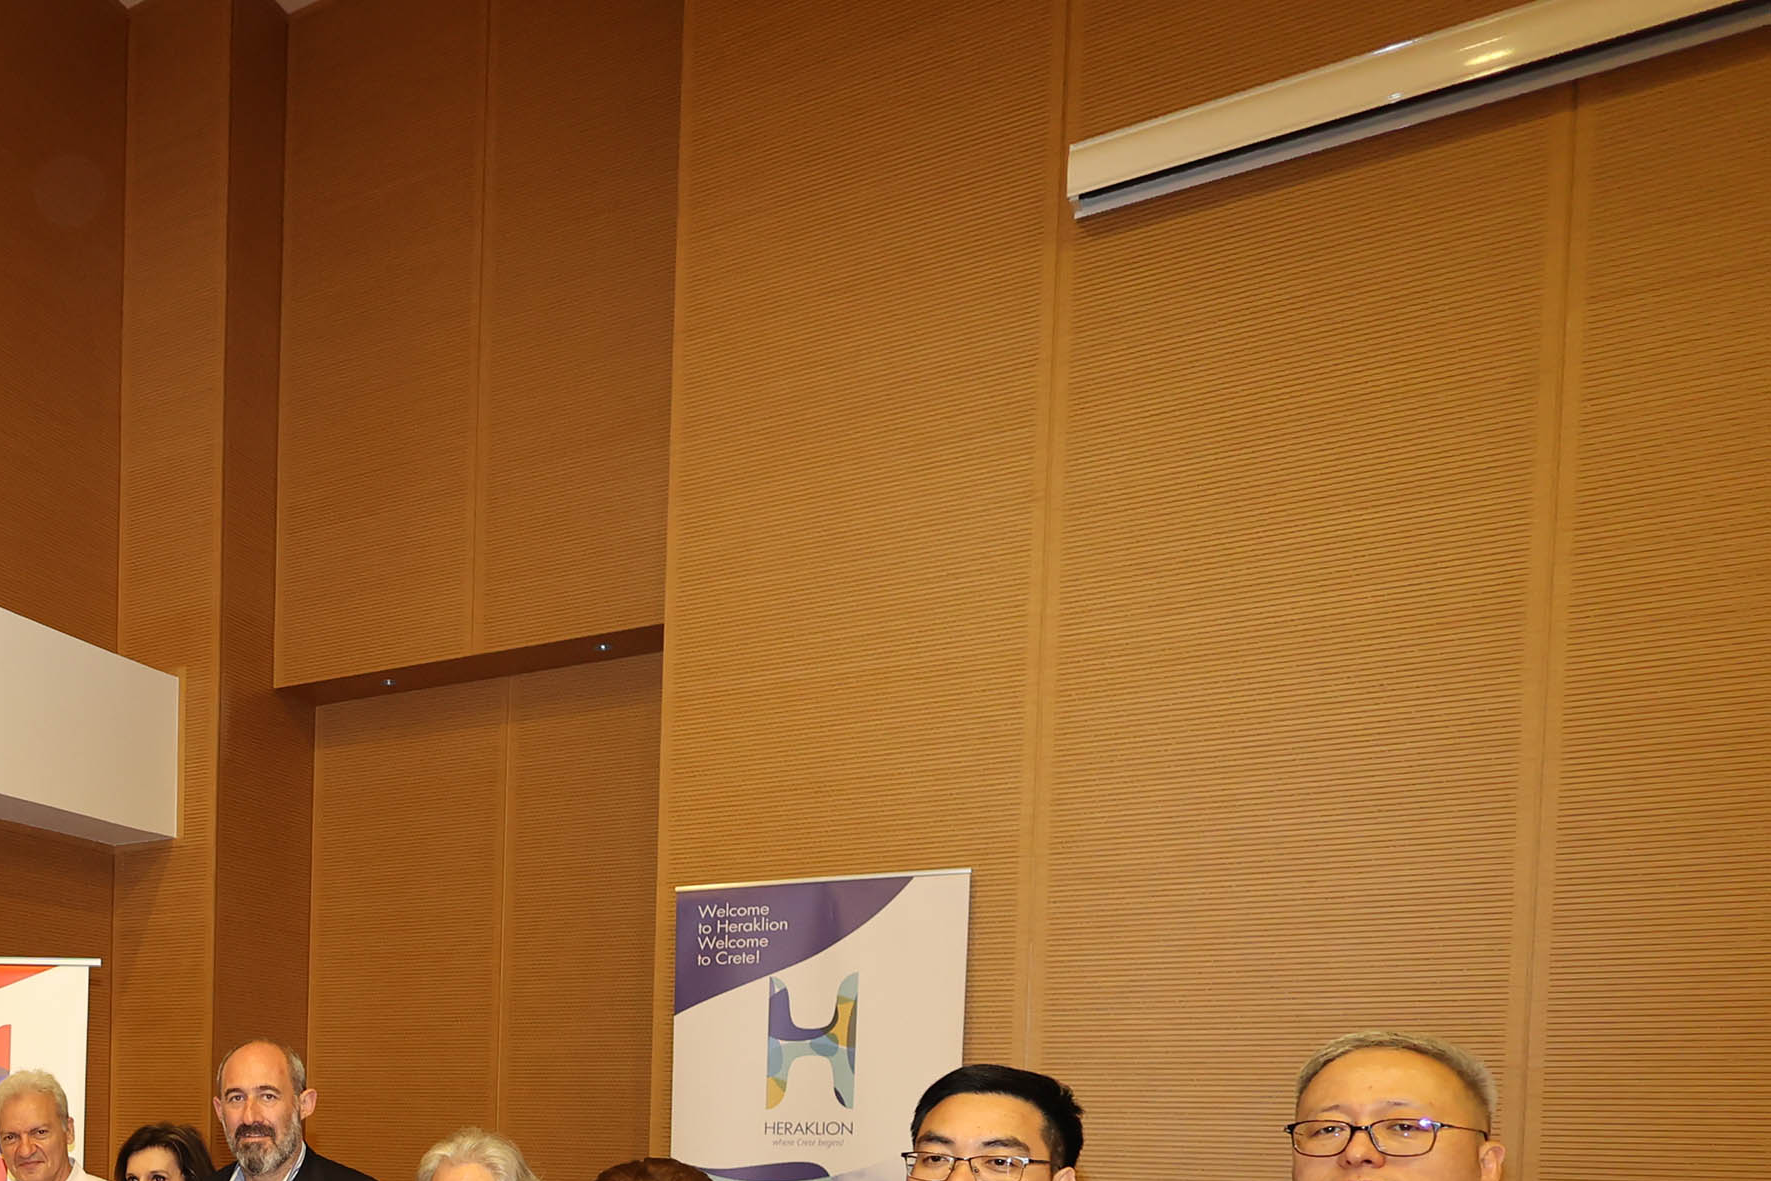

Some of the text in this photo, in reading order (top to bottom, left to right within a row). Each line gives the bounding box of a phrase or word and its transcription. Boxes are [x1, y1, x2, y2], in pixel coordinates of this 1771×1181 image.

[698, 902, 769, 918] Welcome
[698, 917, 788, 934] to Heraklion
[697, 934, 769, 950] Welcome
[697, 954, 711, 966] to
[764, 1121, 854, 1136] HERAKLION
